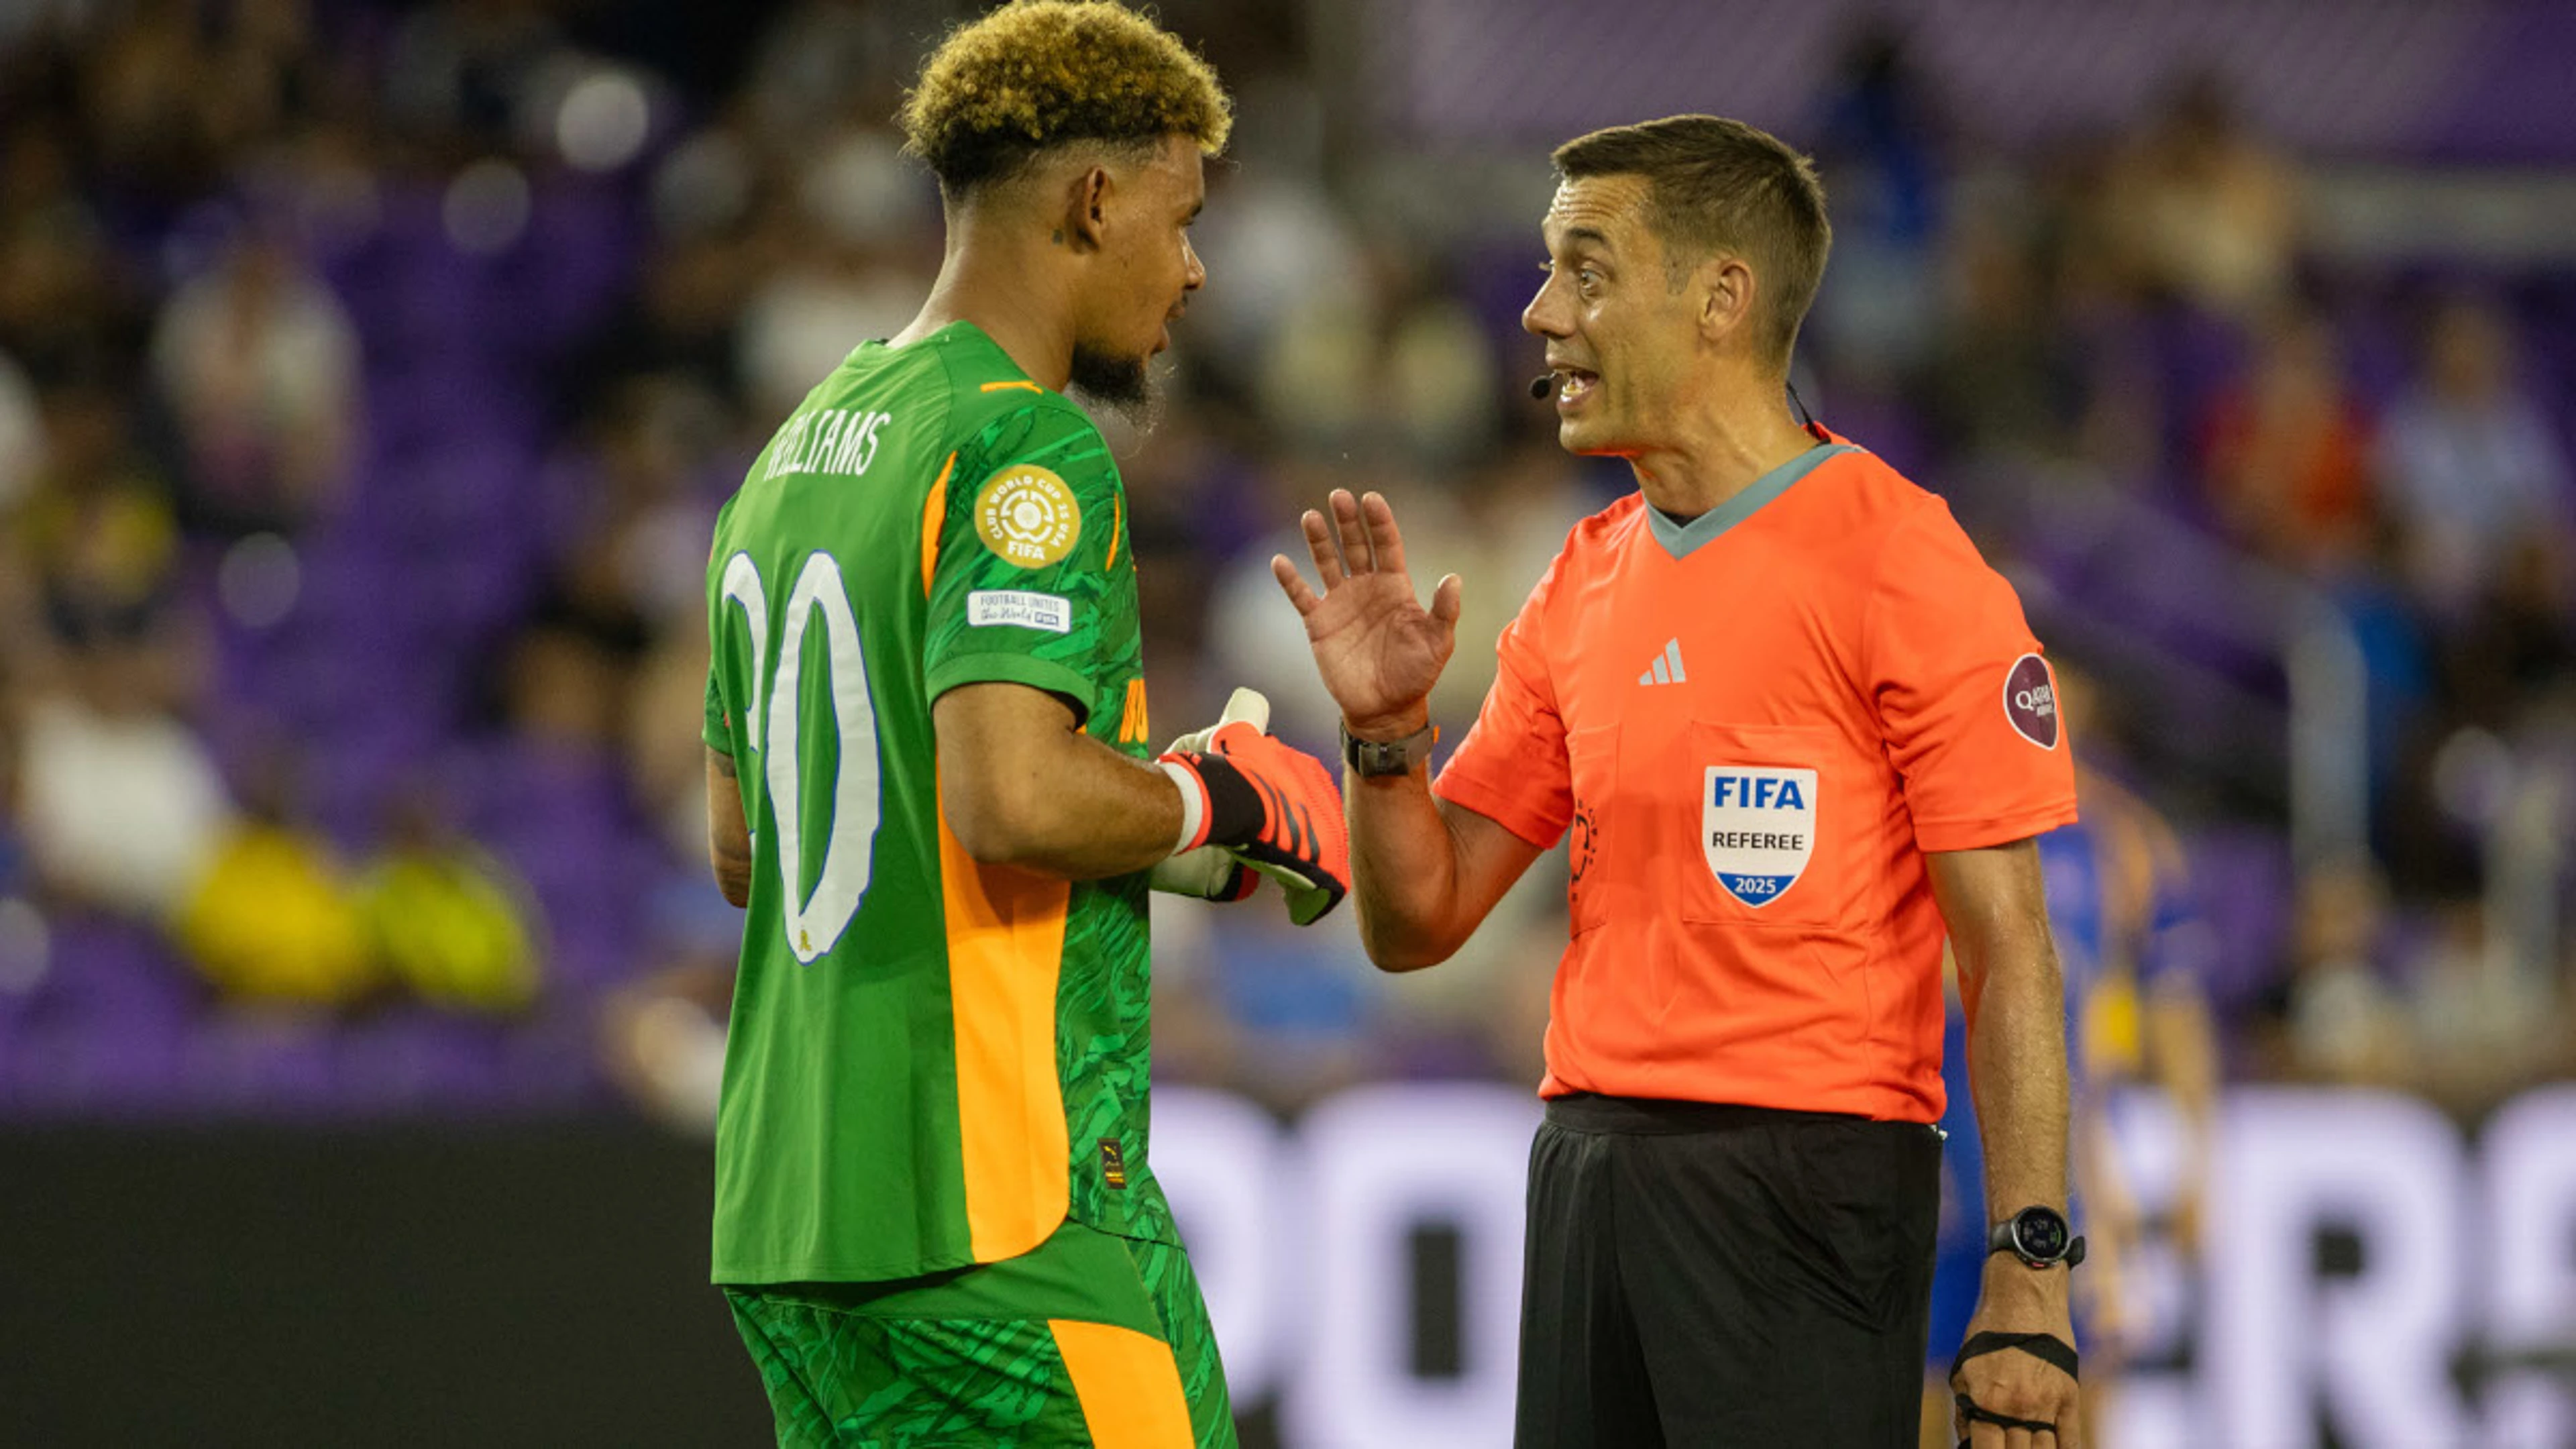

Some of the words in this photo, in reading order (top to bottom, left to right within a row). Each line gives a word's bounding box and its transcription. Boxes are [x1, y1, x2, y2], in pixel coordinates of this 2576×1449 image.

[989, 475, 1033, 504] WORLD
[1036, 478, 1061, 499] CUP
[1008, 540, 1045, 561] FIFA
[1714, 776, 1805, 810] FIFA
[1712, 831, 1804, 851] REFEREE
[1734, 877, 1776, 895] 2025
